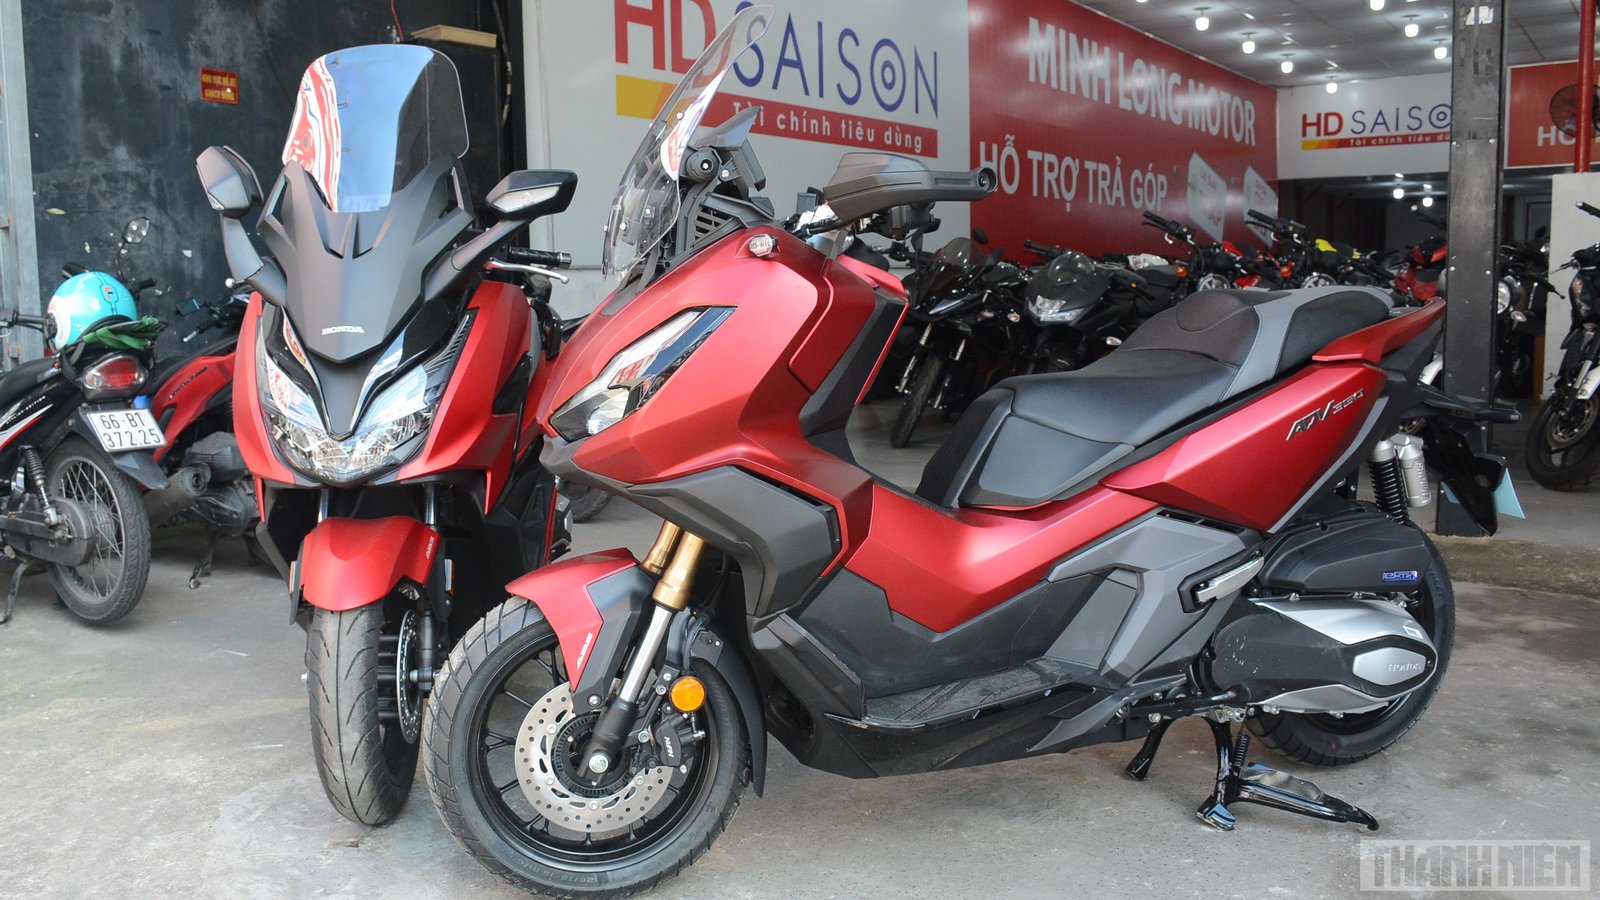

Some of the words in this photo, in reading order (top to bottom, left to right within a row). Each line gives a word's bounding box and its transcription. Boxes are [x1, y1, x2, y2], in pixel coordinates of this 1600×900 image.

[614, 0, 737, 88] HD
[732, 1, 938, 119] SAISON
[1028, 17, 1111, 105] MINH
[1118, 51, 1183, 125] LONG
[1187, 78, 1257, 147] MOTOR
[776, 107, 831, 137] chính
[840, 118, 875, 144] tiêu
[884, 126, 922, 154] dùng
[1301, 111, 1344, 138] HD
[1027, 149, 1080, 213] TRỢ
[1084, 156, 1126, 208] TRẢ
[1129, 163, 1168, 212] GÓP
[321, 325, 365, 336] HONDA
[103, 429, 161, 448] 372.25
